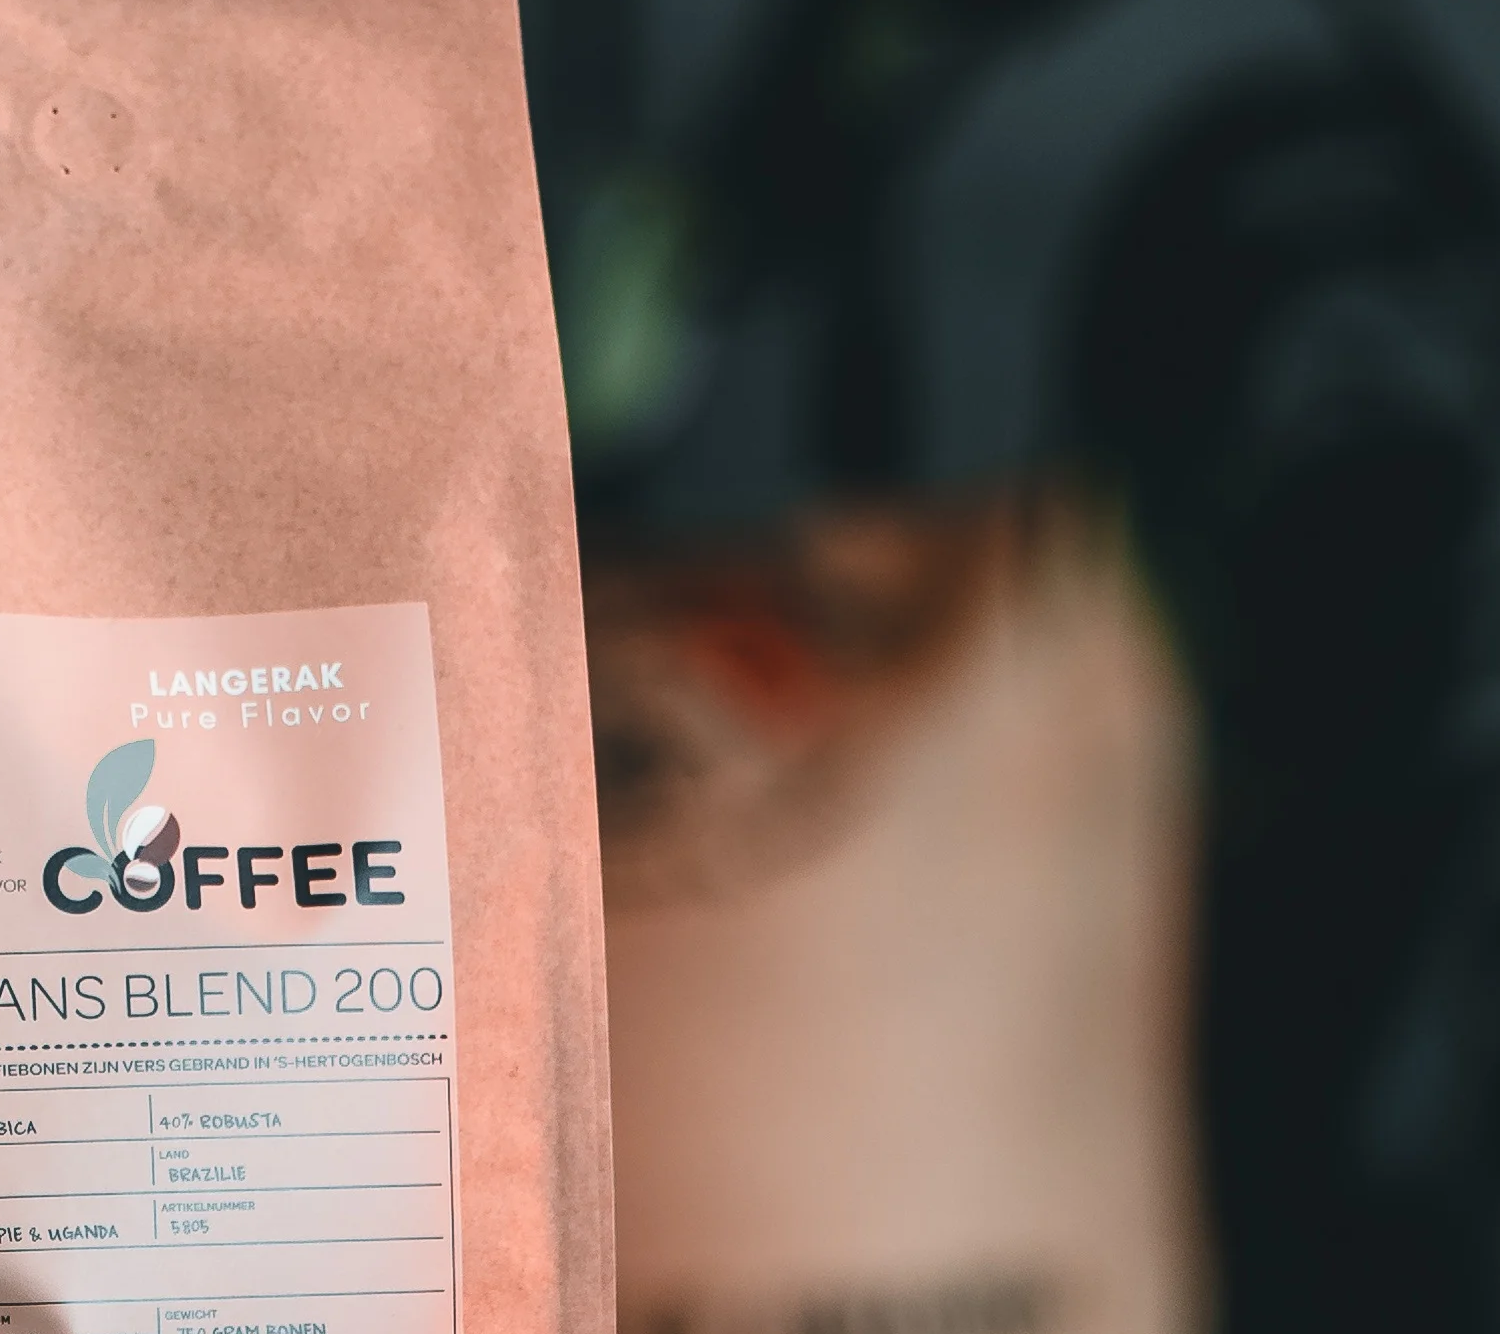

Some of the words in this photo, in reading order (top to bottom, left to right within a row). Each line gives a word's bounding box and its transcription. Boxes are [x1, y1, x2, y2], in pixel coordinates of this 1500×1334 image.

[149, 662, 344, 697] LANGERAK
[130, 702, 217, 730] Pure
[240, 699, 370, 728] Flavor
[43, 840, 405, 914] COFFEE
[126, 969, 318, 1020] BLEND
[334, 967, 443, 1014] 200
[82, 1061, 119, 1075] ZIJN
[123, 1059, 165, 1073] VERS
[169, 1057, 250, 1072] GEBRAND
[254, 1056, 270, 1069] IN
[159, 1113, 194, 1129] 40%
[200, 1113, 282, 1129] ROBUSTA
[159, 1150, 189, 1160] LAND
[168, 1166, 246, 1182] BRAZILIE
[161, 1201, 255, 1212] ARTIKELNUMMER
[29, 1227, 42, 1241] &
[48, 1225, 119, 1241] UGANDA
[165, 1309, 217, 1320] GEWICHT
